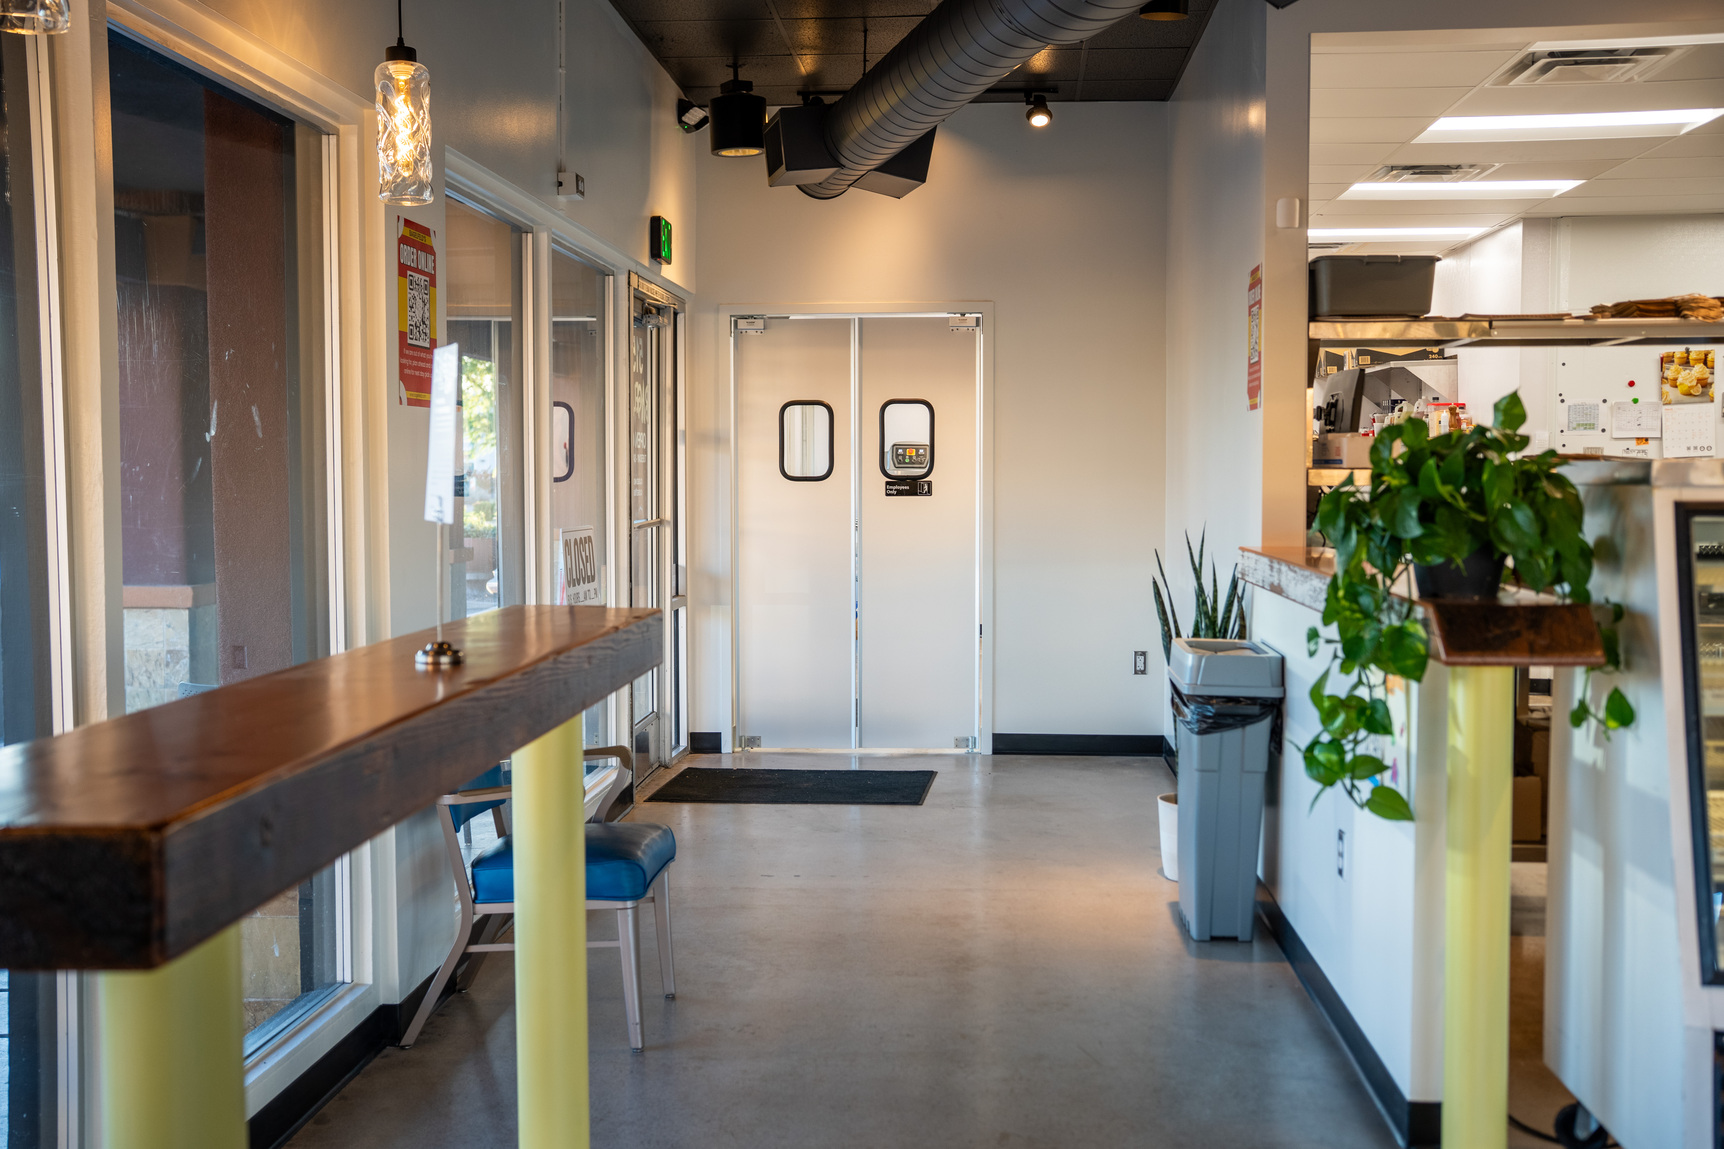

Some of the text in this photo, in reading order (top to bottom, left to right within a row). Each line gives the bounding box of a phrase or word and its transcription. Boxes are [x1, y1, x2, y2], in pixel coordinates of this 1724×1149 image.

[400, 243, 434, 274] ORDER ONLINE
[564, 535, 596, 588] CLOSED
